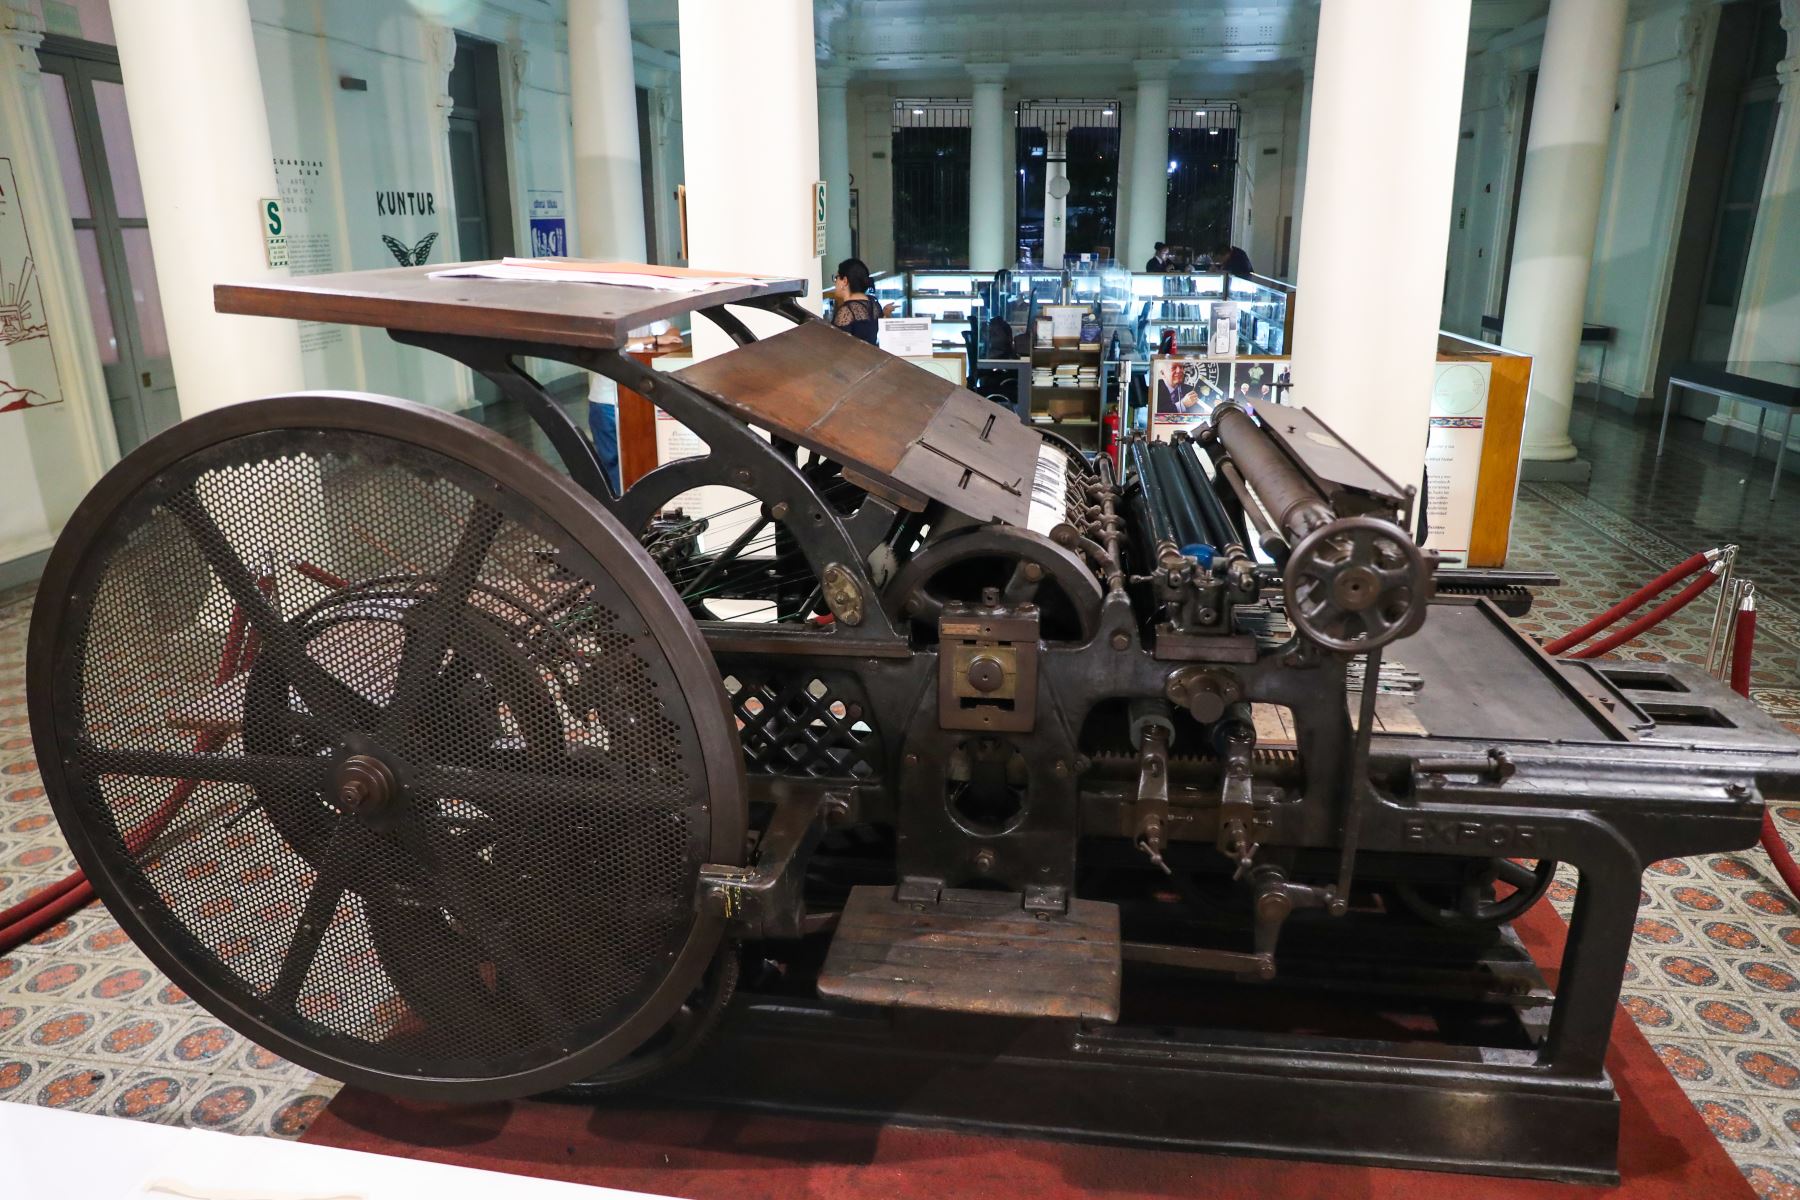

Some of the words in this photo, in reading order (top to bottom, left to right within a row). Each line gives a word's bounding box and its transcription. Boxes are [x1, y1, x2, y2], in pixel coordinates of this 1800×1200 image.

[267, 201, 282, 235] S
[376, 190, 436, 217] KUNTUR
[818, 185, 825, 222] S
[1404, 817, 1566, 850] EXPORT
